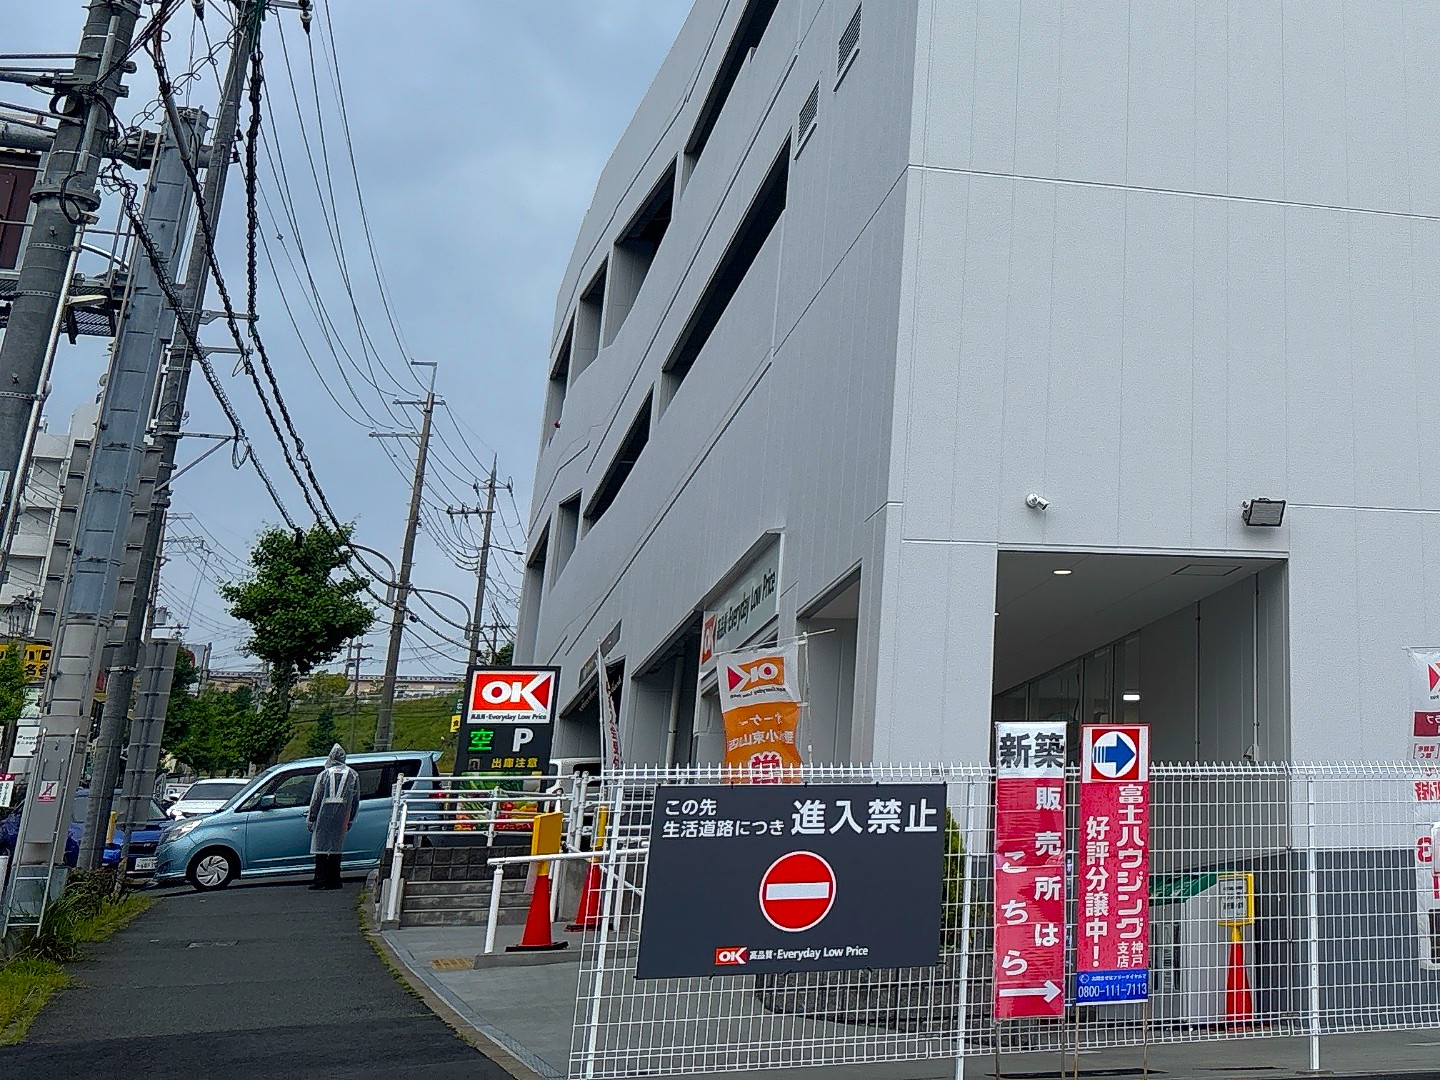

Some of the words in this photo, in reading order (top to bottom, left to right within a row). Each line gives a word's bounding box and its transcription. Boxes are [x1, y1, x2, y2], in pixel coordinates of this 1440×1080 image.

[481, 673, 549, 711] OK
[468, 728, 494, 752] 空
[512, 727, 534, 753] P
[1000, 731, 1066, 769] 新築
[491, 757, 538, 769] 出庫注意
[665, 798, 717, 816] この先
[790, 798, 939, 835] 進入禁止
[661, 819, 785, 839] 生活道路につき
[1116, 783, 1145, 939] 富士ハウジング
[1001, 850, 1029, 976] こちら
[718, 946, 748, 965] OK
[823, 946, 843, 958] Low
[845, 945, 869, 957] Price
[1078, 982, 1147, 999] 0800-111-7113
